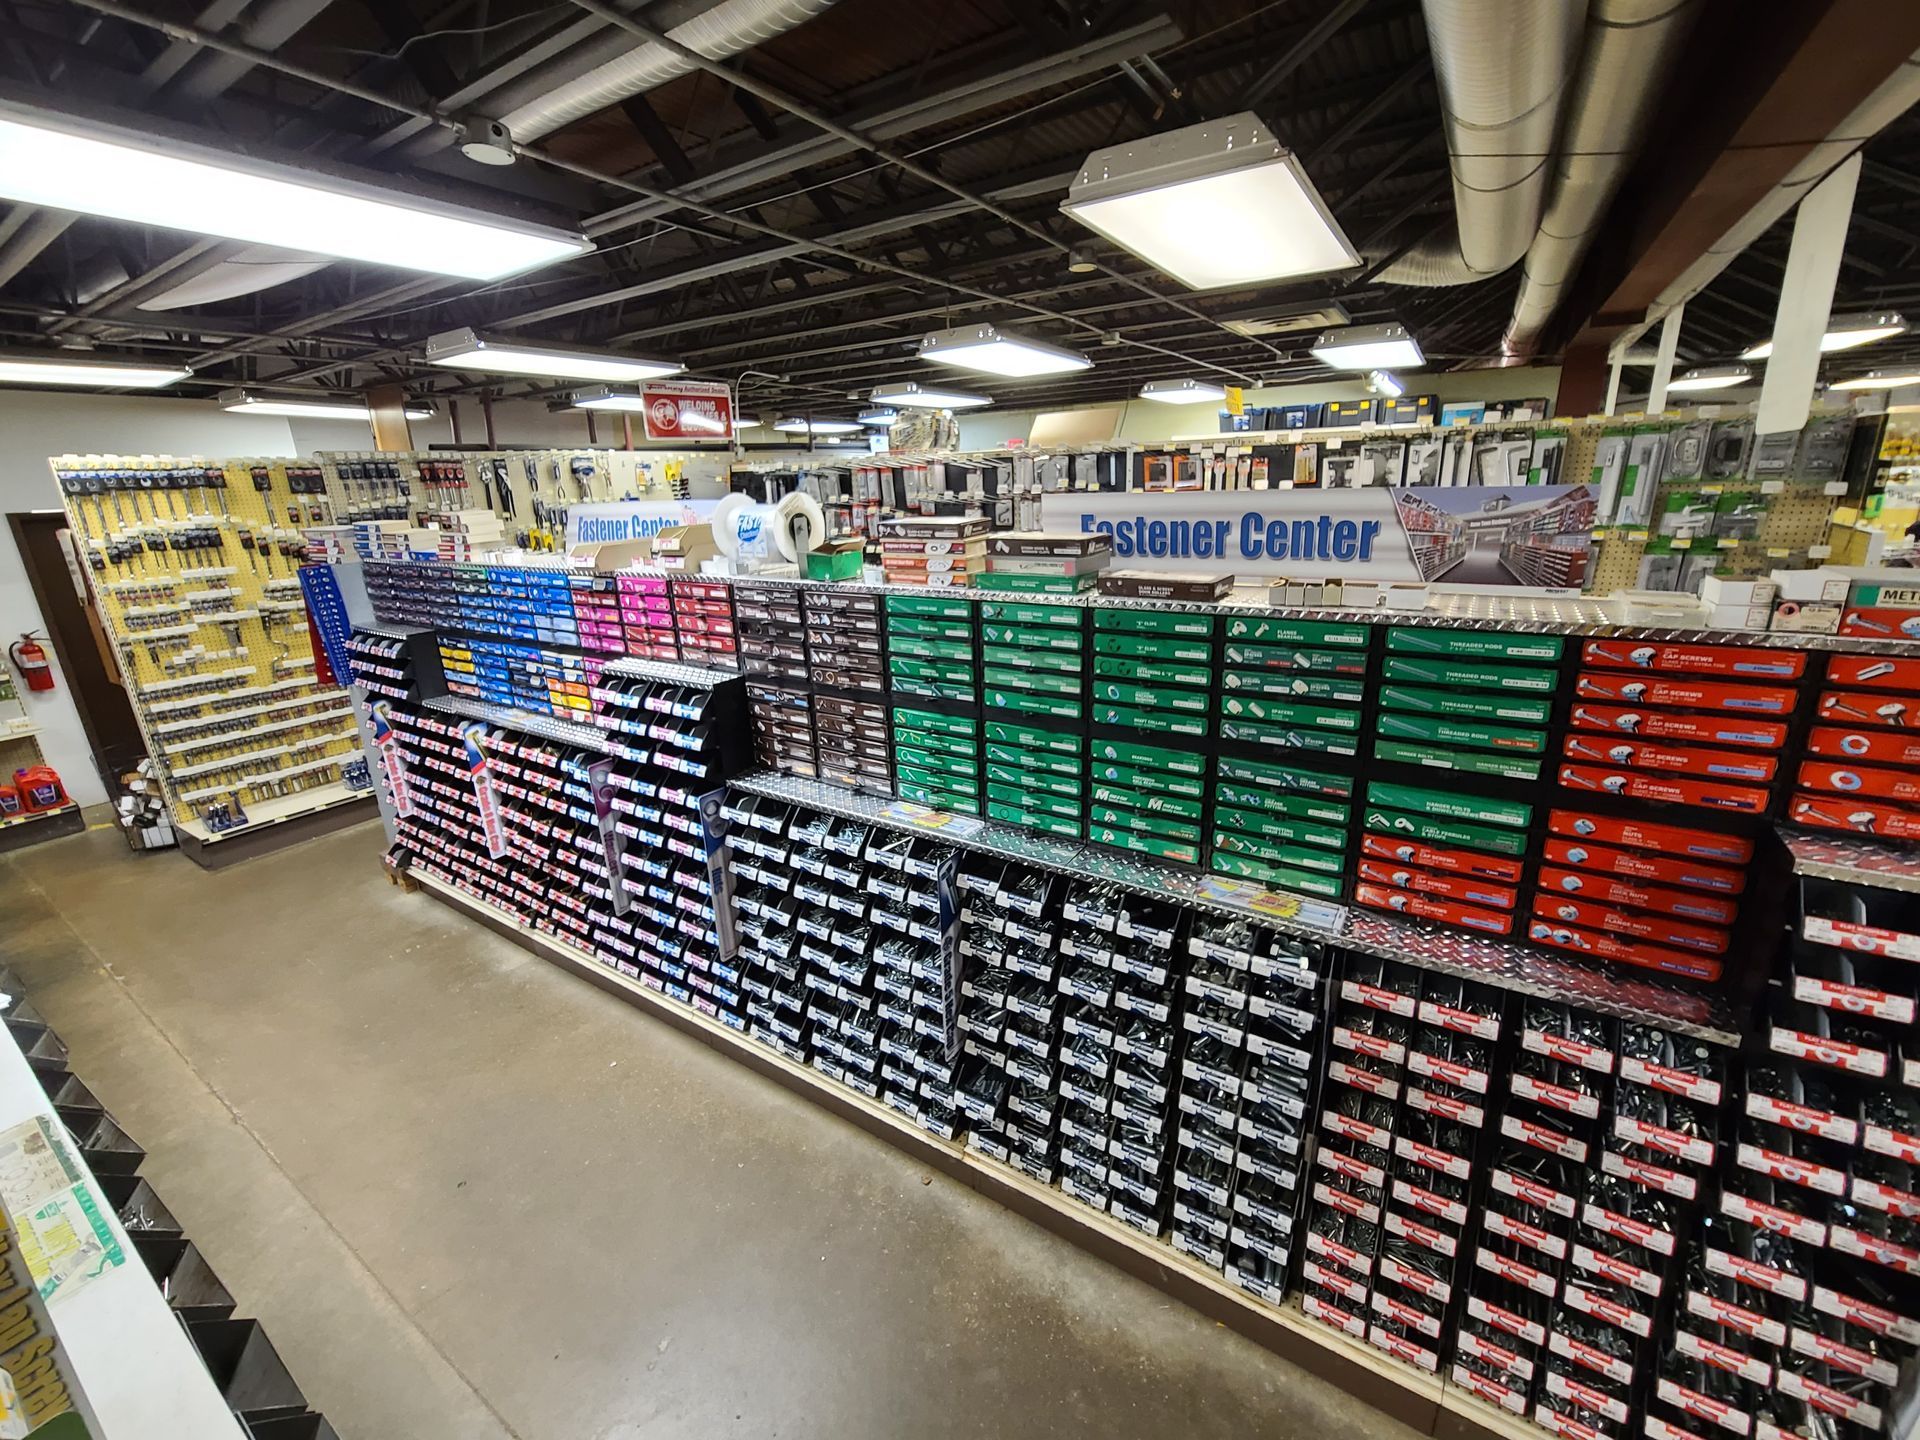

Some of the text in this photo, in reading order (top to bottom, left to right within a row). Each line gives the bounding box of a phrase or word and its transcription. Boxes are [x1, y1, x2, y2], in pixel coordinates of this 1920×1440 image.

[677, 399, 716, 412] WELDING
[577, 515, 629, 543] Fastener
[1239, 511, 1381, 562] Center
[1882, 589, 1920, 601] MET
[1449, 641, 1484, 650] THREADED
[1662, 653, 1714, 663] CAP SCREWS
[1446, 671, 1480, 680] THREADED
[1653, 688, 1703, 699] CAP SCREWS
[1441, 701, 1493, 712] THREADED RODS
[1647, 719, 1697, 731] CAP SCREWS
[1437, 729, 1471, 738] THREADED
[1640, 751, 1689, 764] CAP SCREWS
[1633, 781, 1681, 794] CAP SCREWS
[1623, 831, 1643, 839] NUTS
[1419, 851, 1457, 864] CAP SCREWS
[1615, 859, 1656, 872] LOCK NUTS
[1415, 877, 1452, 889] CAP SCREWS
[1411, 901, 1448, 915] CAP SCREWS
[943, 951, 953, 992] Grade
[945, 999, 955, 1028] Hex
[945, 1021, 956, 1051] Cap
